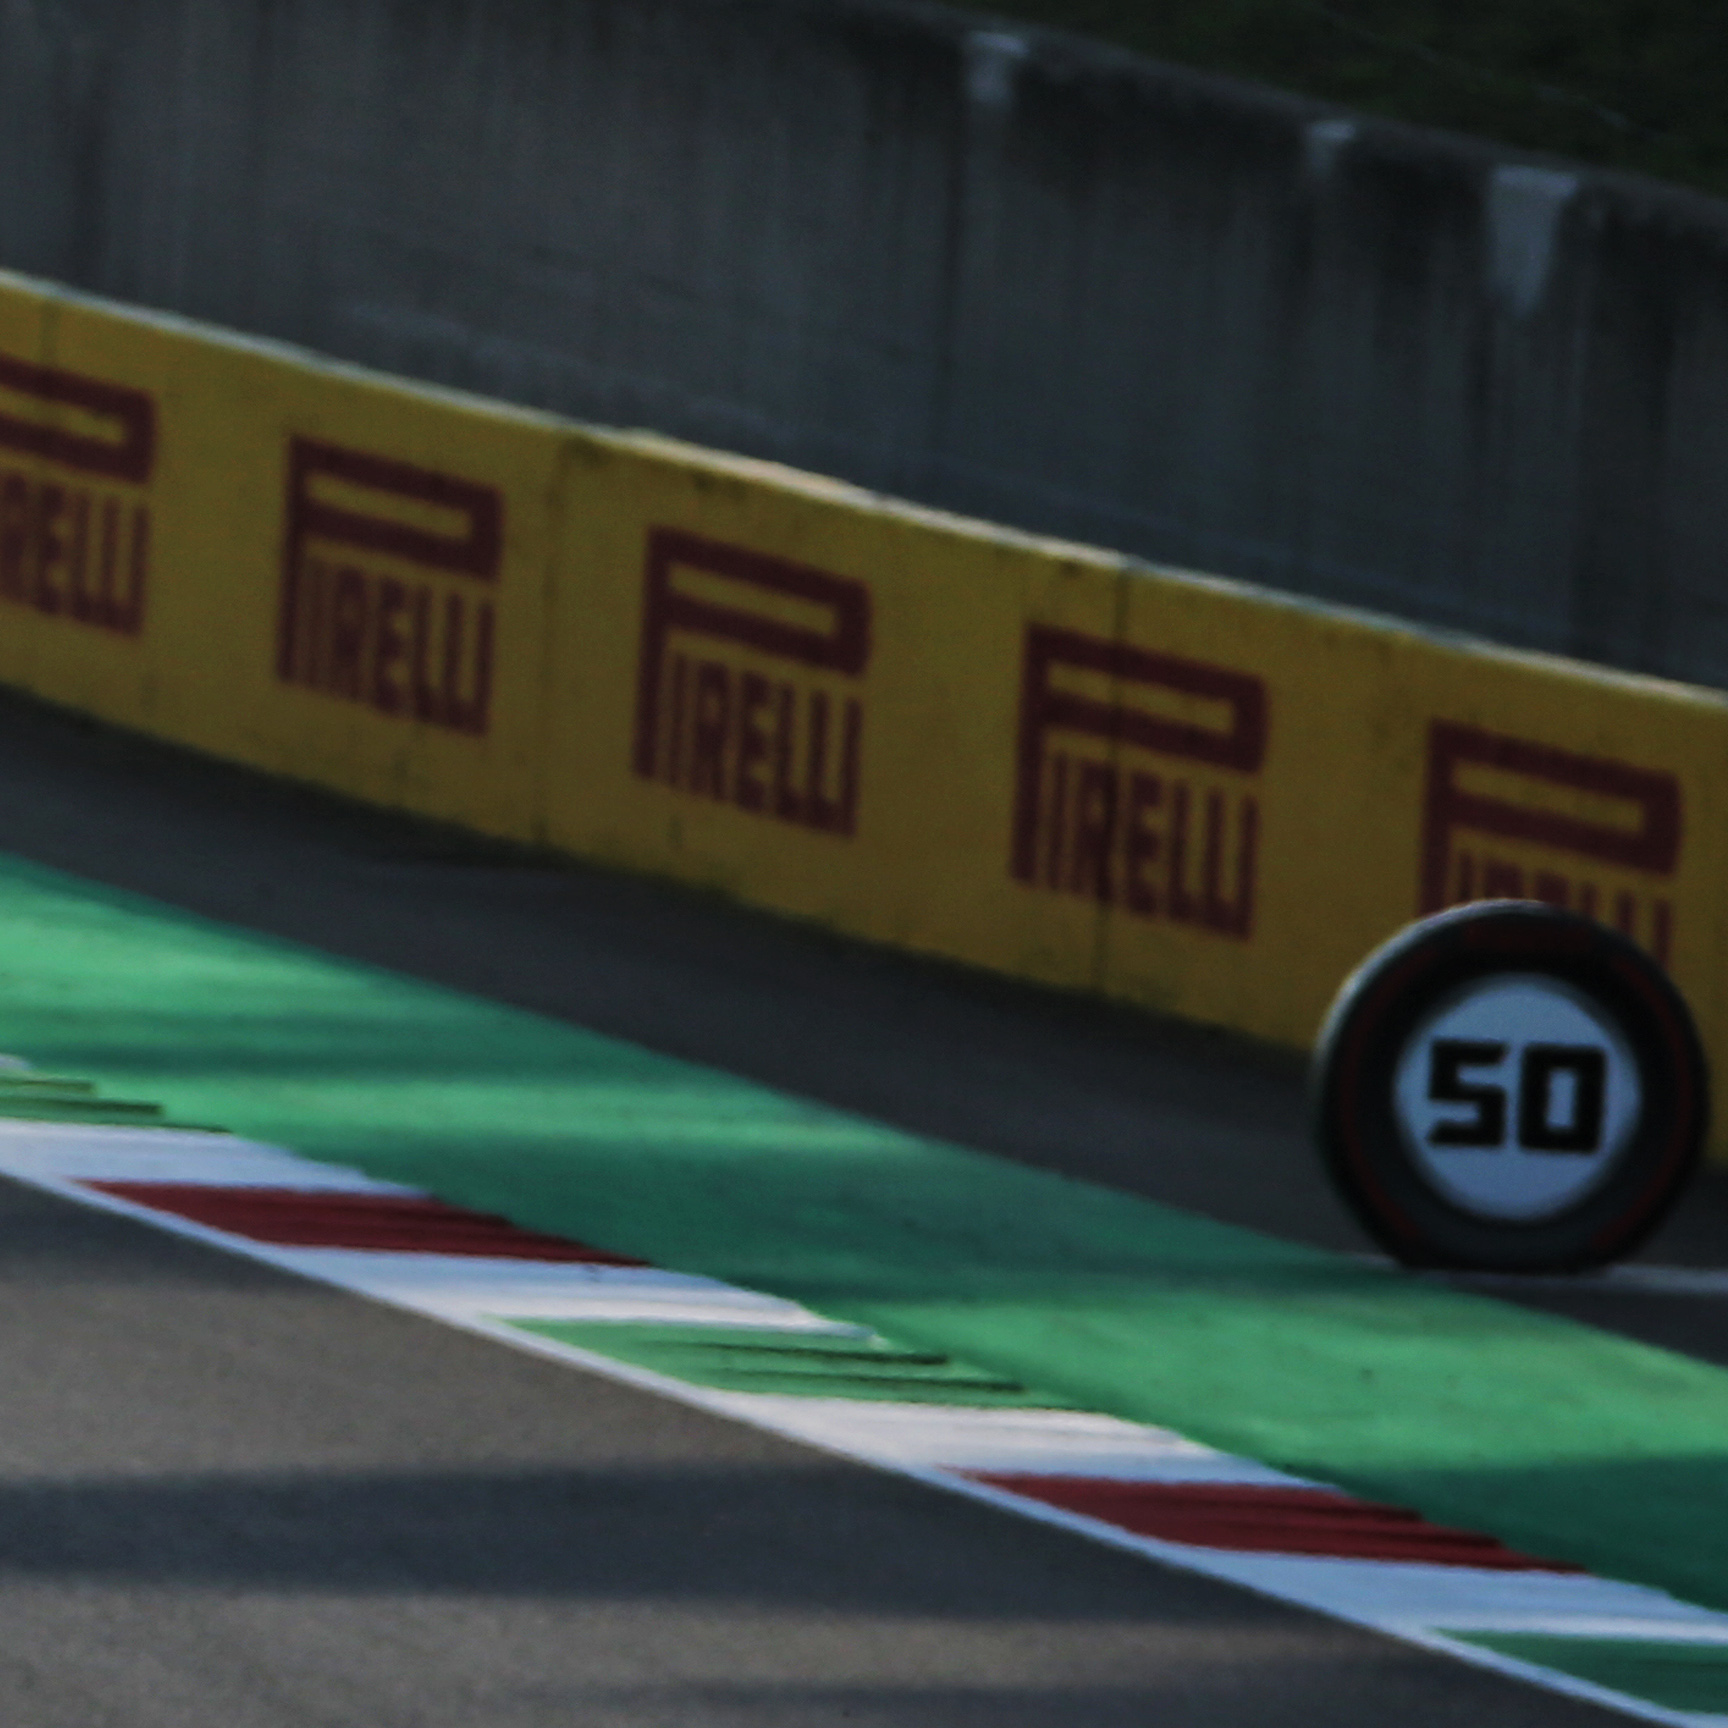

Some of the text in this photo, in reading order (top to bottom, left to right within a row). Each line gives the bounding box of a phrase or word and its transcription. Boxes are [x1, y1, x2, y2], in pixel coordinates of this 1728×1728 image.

[275, 431, 505, 740] PIRELLI
[631, 522, 874, 842] PIRELLI
[1010, 619, 1270, 945] PIRELLI
[1425, 1038, 1608, 1154] 50
